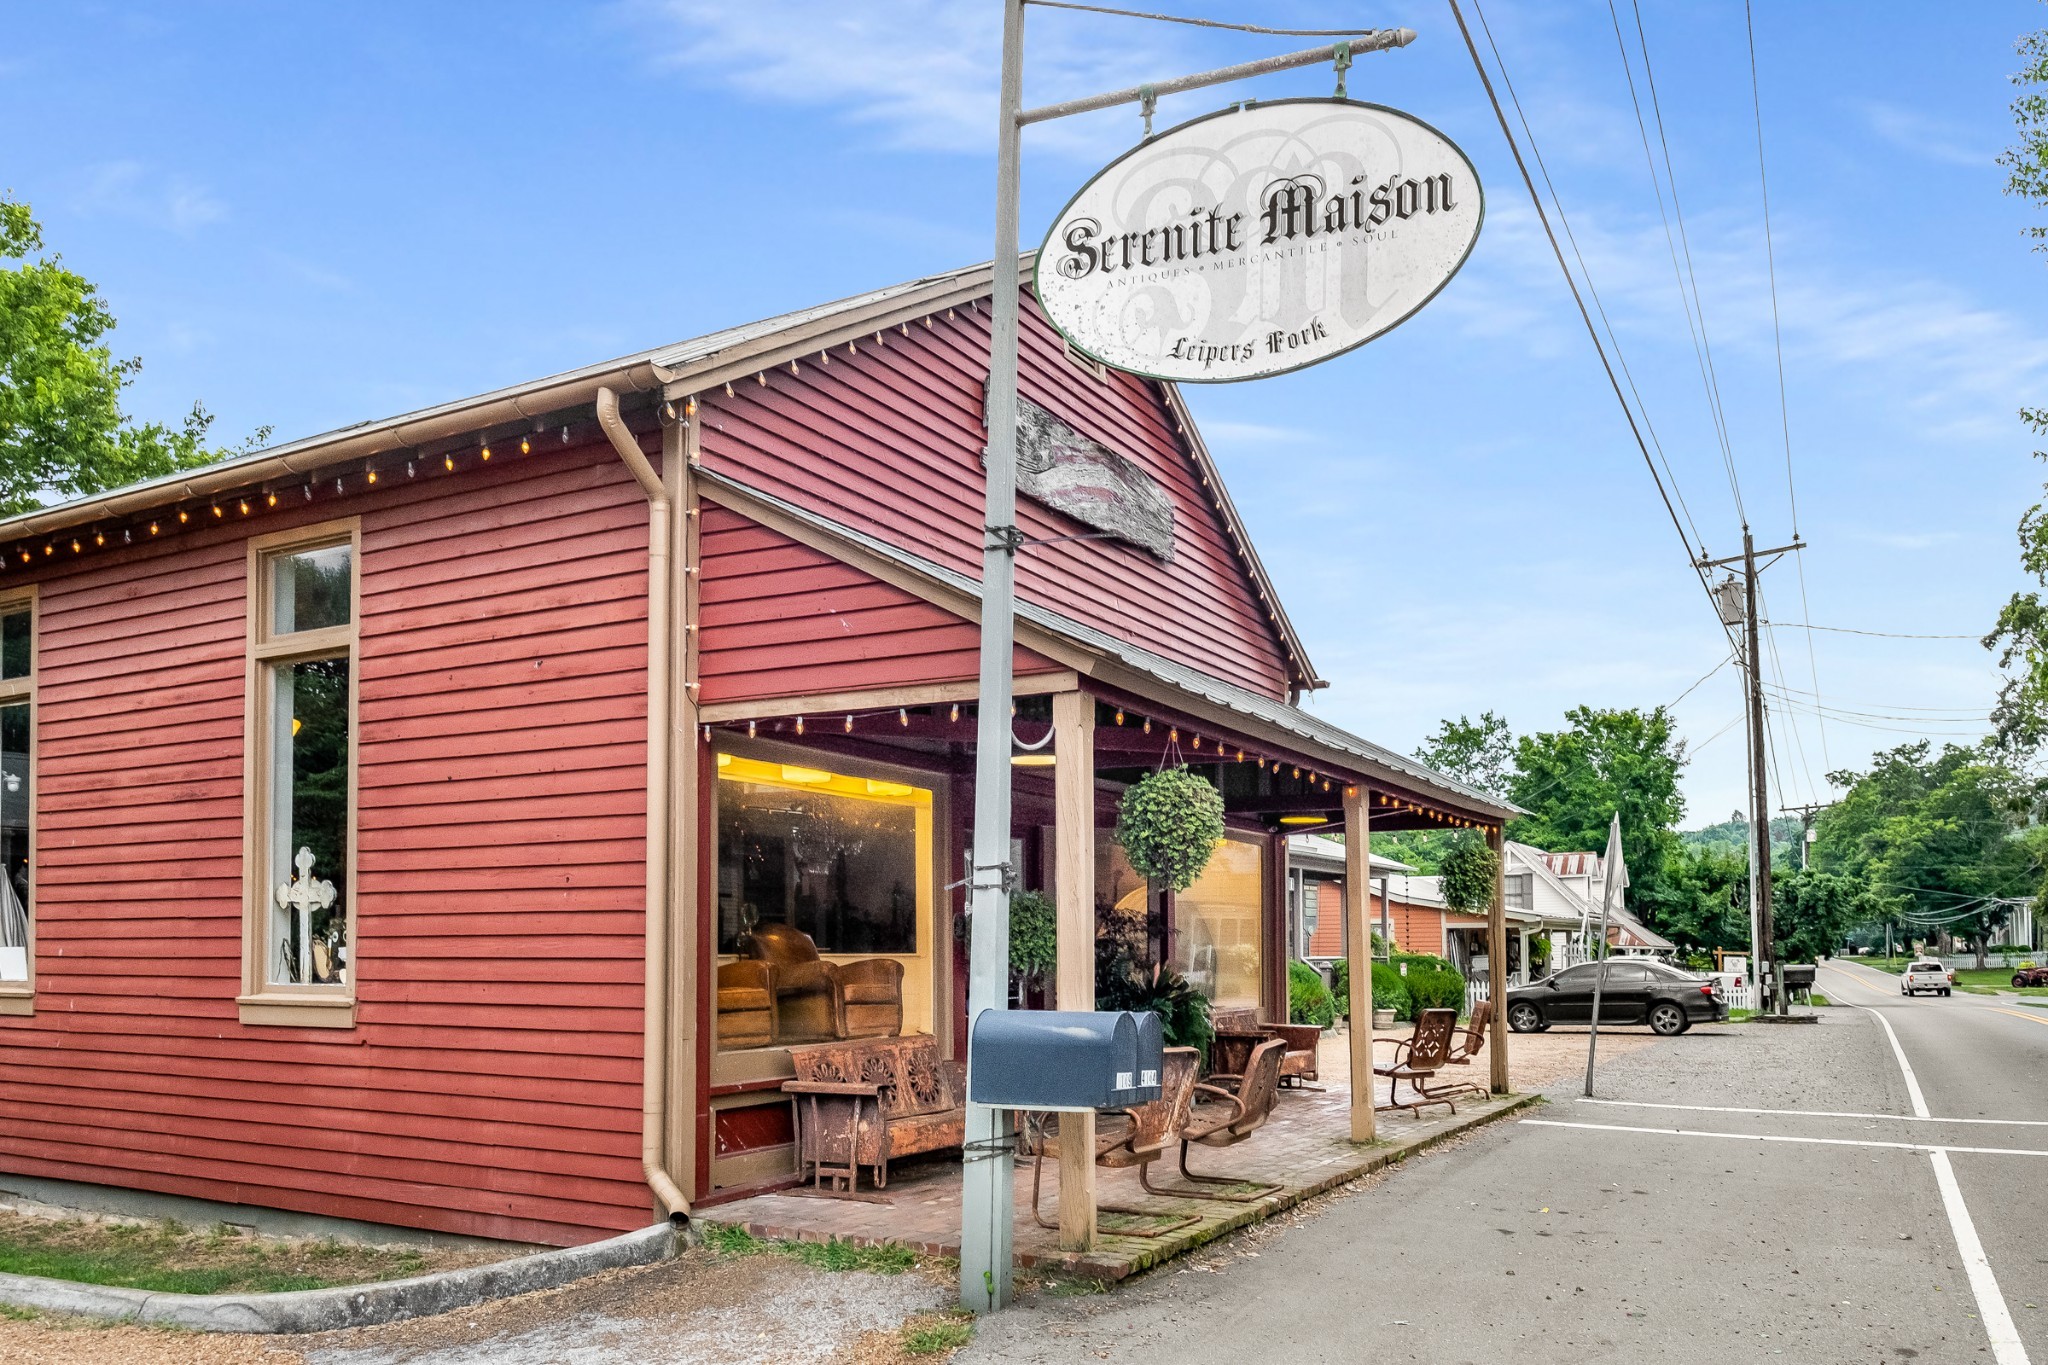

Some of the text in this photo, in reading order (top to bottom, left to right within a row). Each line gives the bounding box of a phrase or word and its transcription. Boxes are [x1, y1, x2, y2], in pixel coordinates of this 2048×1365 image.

[1056, 172, 1458, 279] Serenite Maison
[1106, 230, 1399, 289] ANTIQUES MERCANTILE SOUL
[1166, 316, 1329, 370] Leipers Fork
